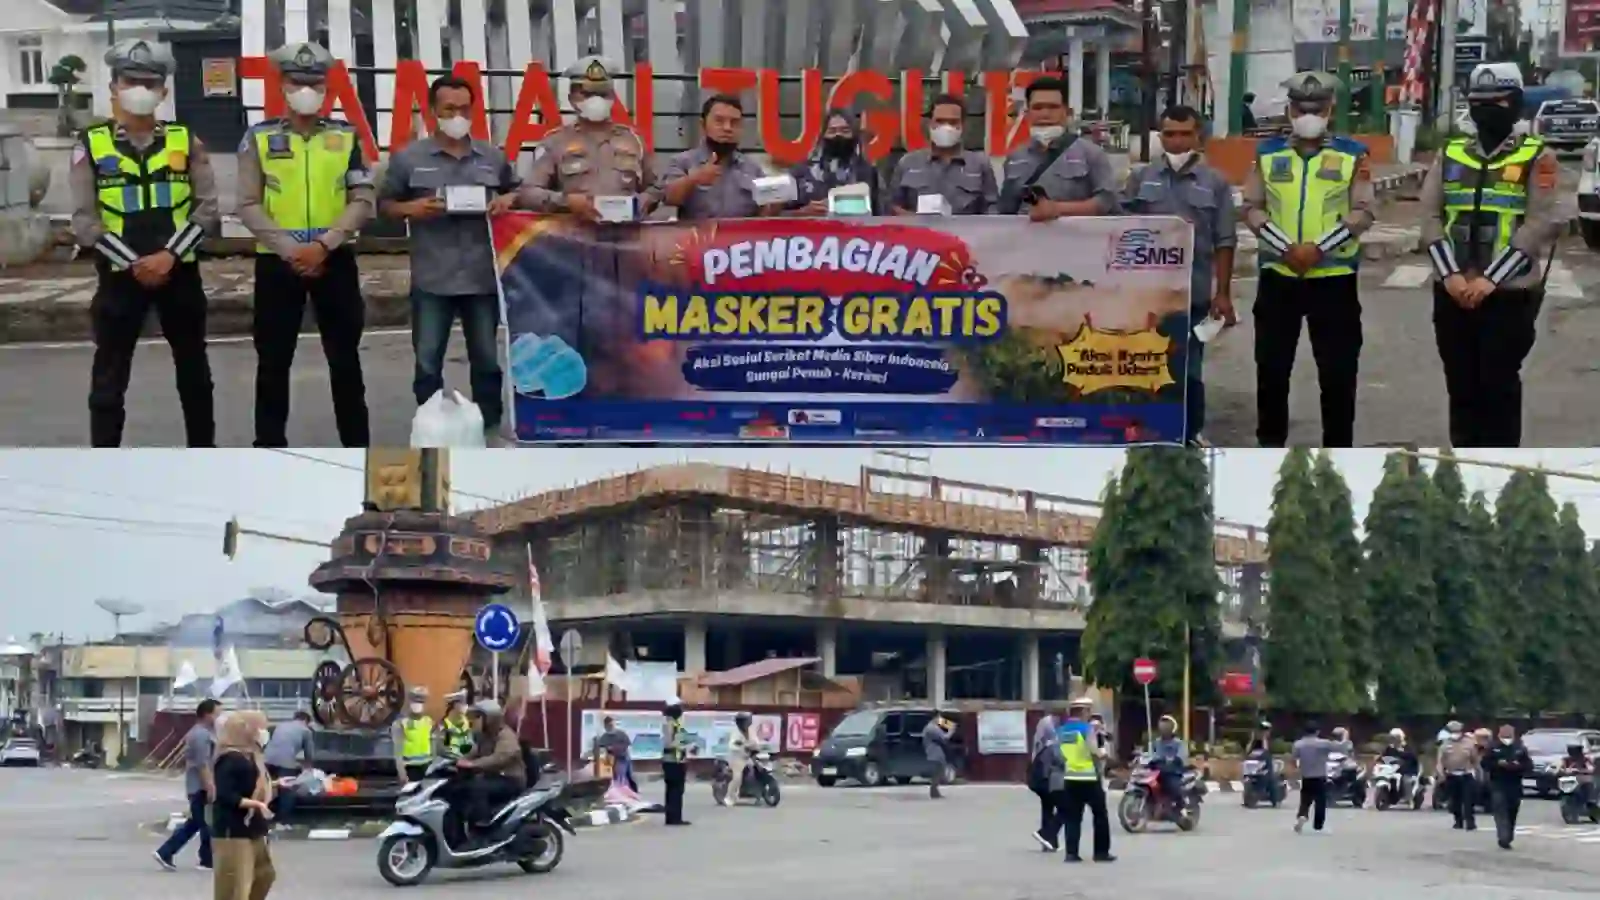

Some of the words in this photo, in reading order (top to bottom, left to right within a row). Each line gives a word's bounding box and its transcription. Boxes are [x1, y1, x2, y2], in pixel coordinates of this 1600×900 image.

[703, 236, 942, 284] PEMBAGIAN
[1134, 247, 1185, 266] SMSI
[643, 295, 825, 335] MASKER
[842, 297, 1002, 337] GRATIS
[723, 351, 763, 367] Sosial
[813, 348, 852, 361] Media
[853, 350, 887, 364] Siber
[887, 352, 949, 371] Indonesia
[745, 366, 790, 383] Sungai
[792, 366, 832, 379] Penuh
